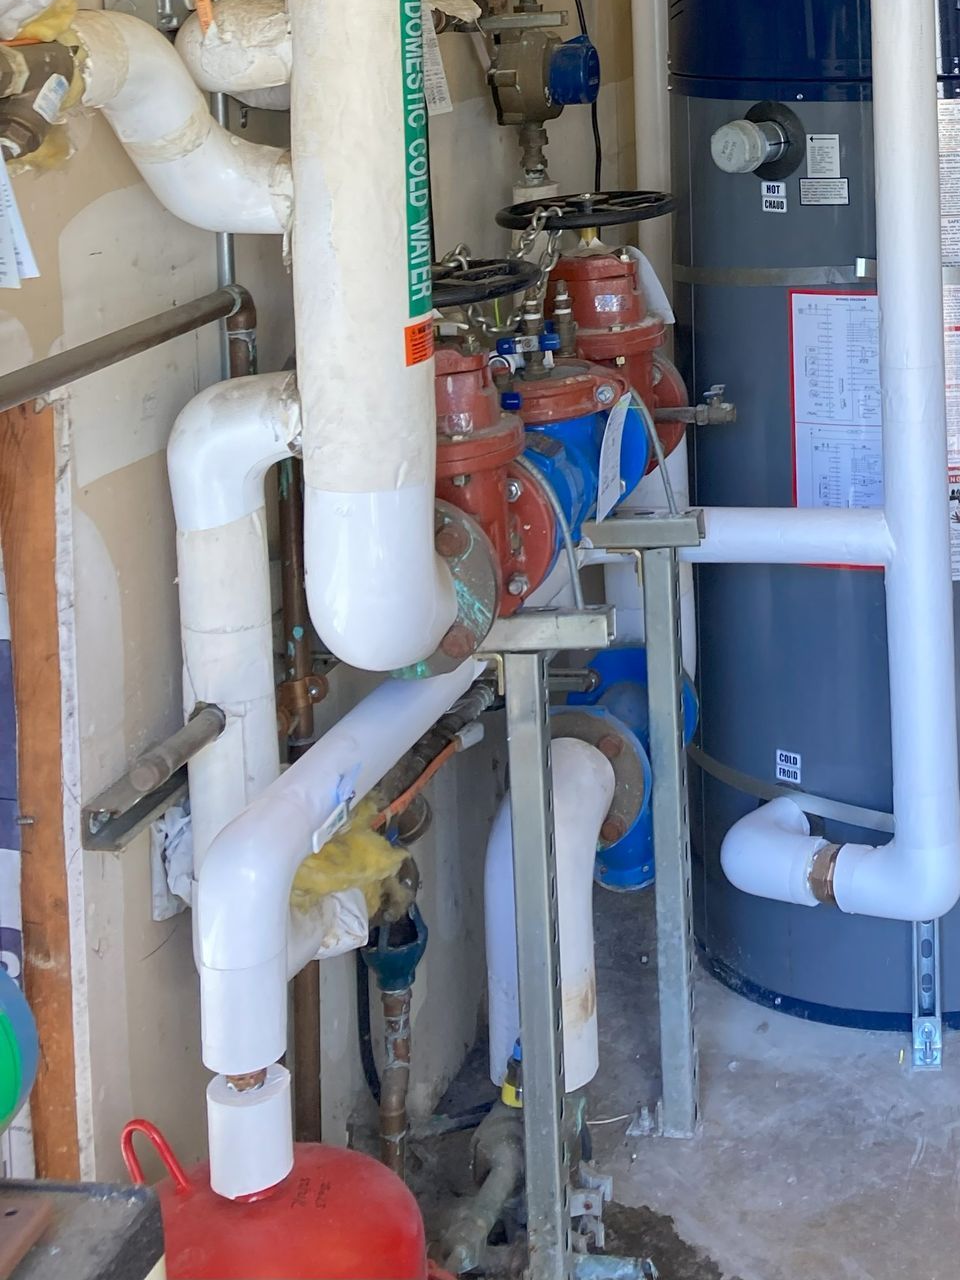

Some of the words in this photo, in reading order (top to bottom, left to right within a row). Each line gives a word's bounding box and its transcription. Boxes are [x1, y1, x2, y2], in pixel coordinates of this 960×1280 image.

[404, 1, 427, 128] DOMESTIC
[408, 142, 430, 208] COLD
[766, 184, 780, 194] HOT
[764, 199, 785, 210] CHAUD
[409, 218, 433, 303] WATER
[780, 753, 798, 766] COLD
[779, 767, 798, 780] FROID
